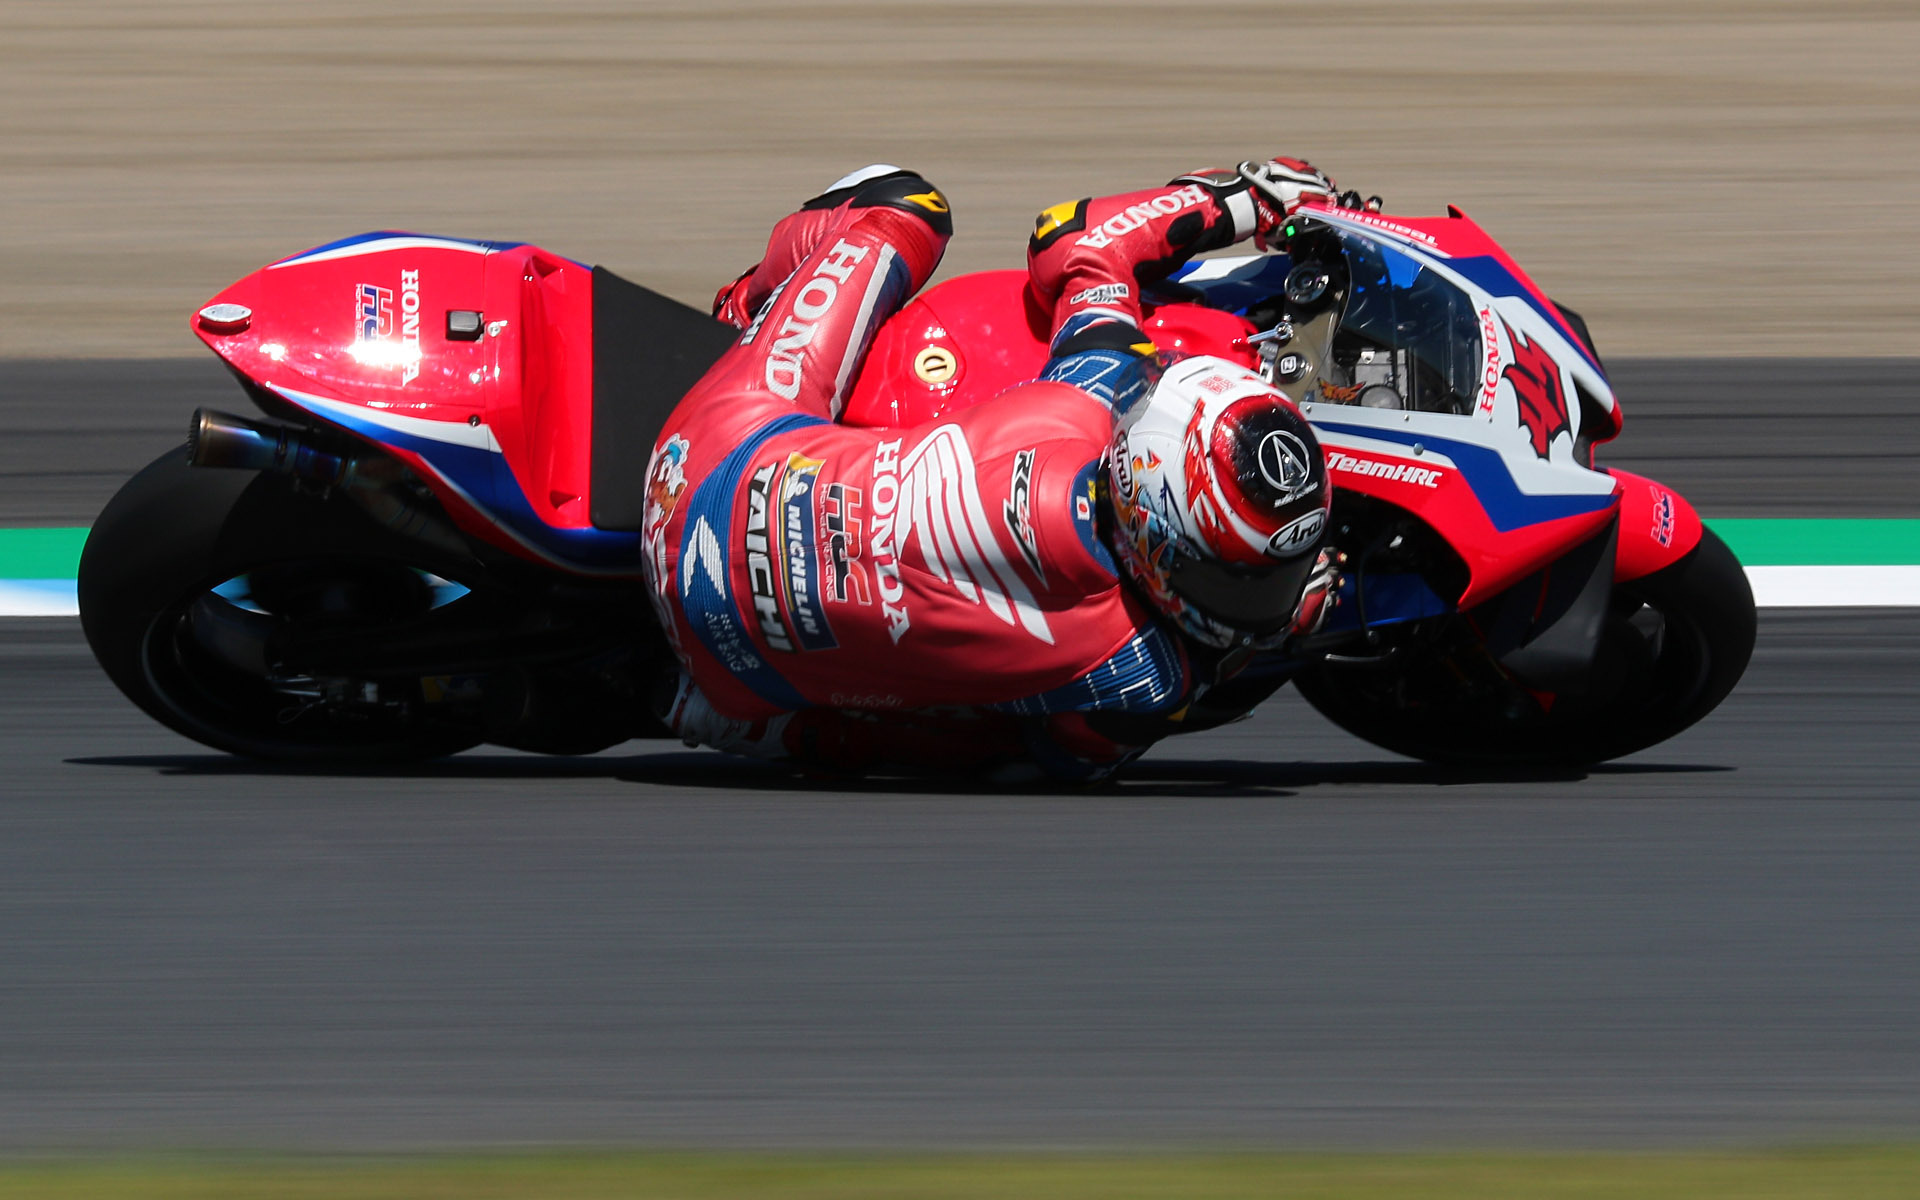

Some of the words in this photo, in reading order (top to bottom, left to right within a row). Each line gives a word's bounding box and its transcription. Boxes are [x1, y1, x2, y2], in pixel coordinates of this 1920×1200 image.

[1075, 184, 1209, 248] HONDA
[1480, 306, 1503, 415] HONDA
[819, 483, 829, 538] Honda
[1114, 447, 1131, 490] Arai
[747, 463, 793, 652] TAICHI
[789, 505, 820, 635] MICHELIN
[820, 541, 834, 602] RACING
[828, 483, 872, 605] HRC
[870, 438, 909, 646] HONDA
[1276, 514, 1325, 548] Arai
